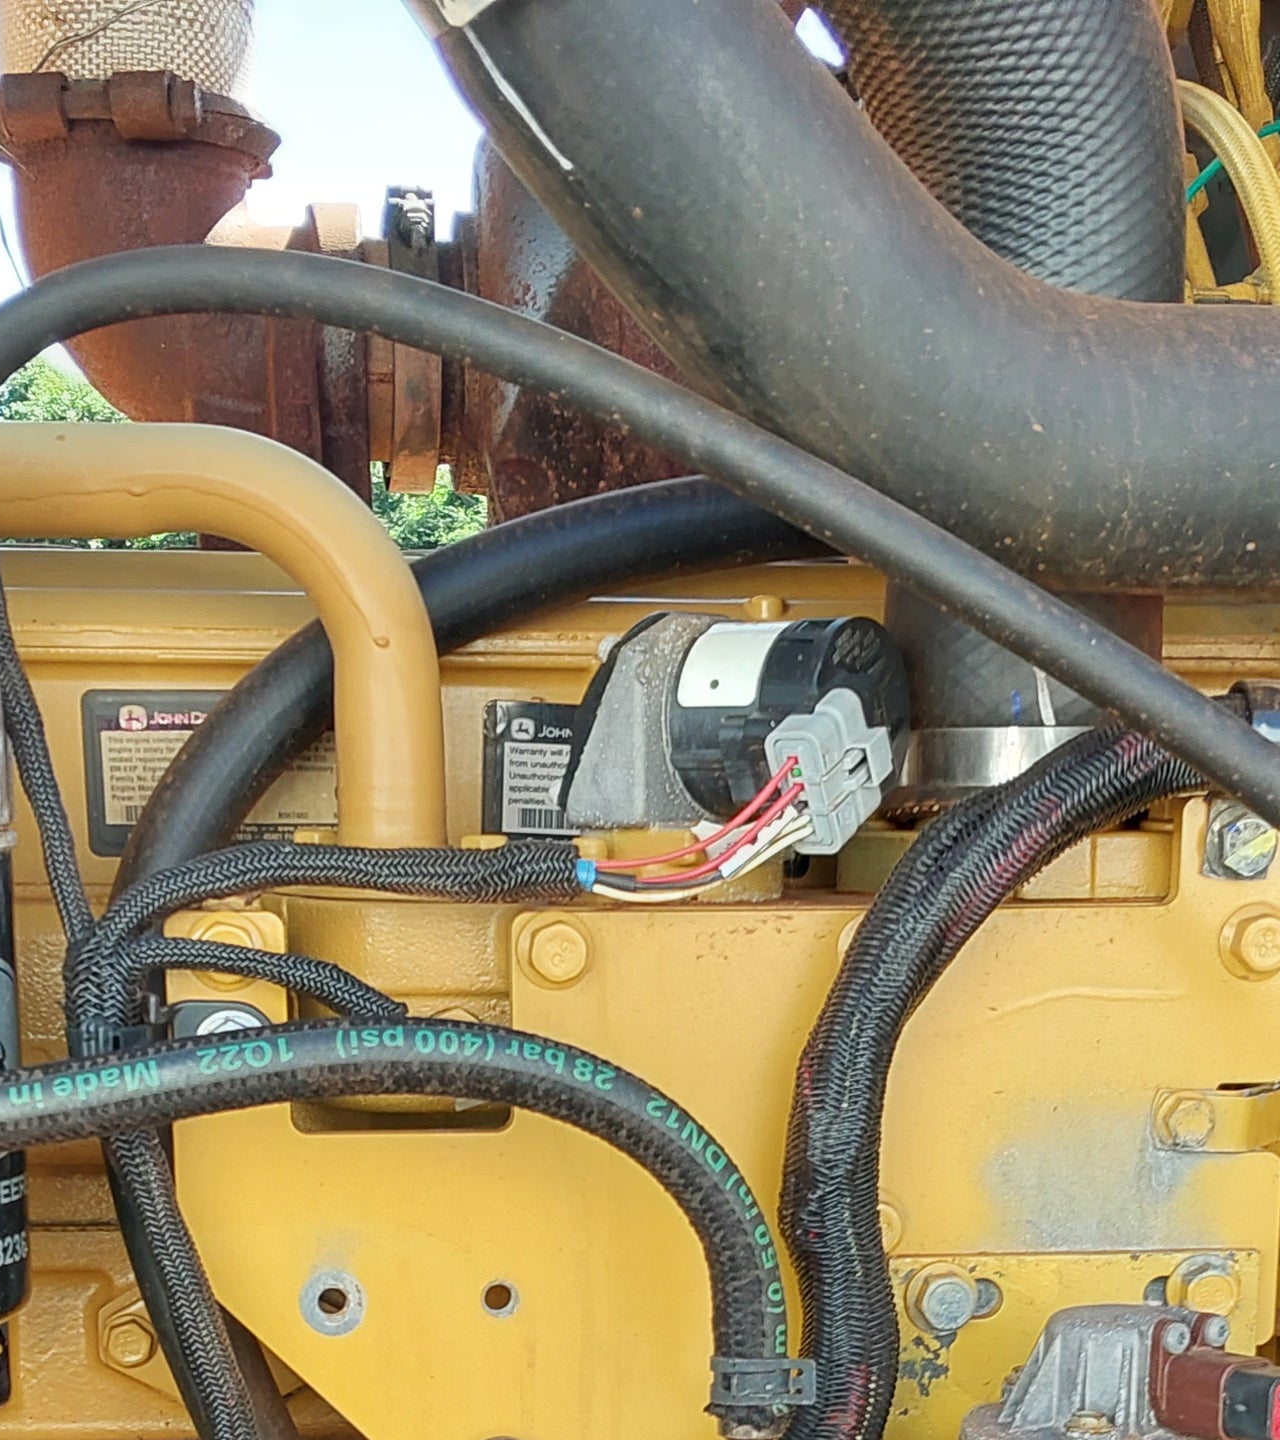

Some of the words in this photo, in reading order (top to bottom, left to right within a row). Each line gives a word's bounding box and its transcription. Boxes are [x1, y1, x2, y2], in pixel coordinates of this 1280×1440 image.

[335, 1026, 406, 1059] psi)
[414, 1029, 496, 1061] (400
[503, 1038, 567, 1072] bar
[52, 1059, 160, 1099] Made
[572, 1056, 617, 1090] 28
[8, 1080, 44, 1109] in
[645, 1091, 728, 1174] DN12
